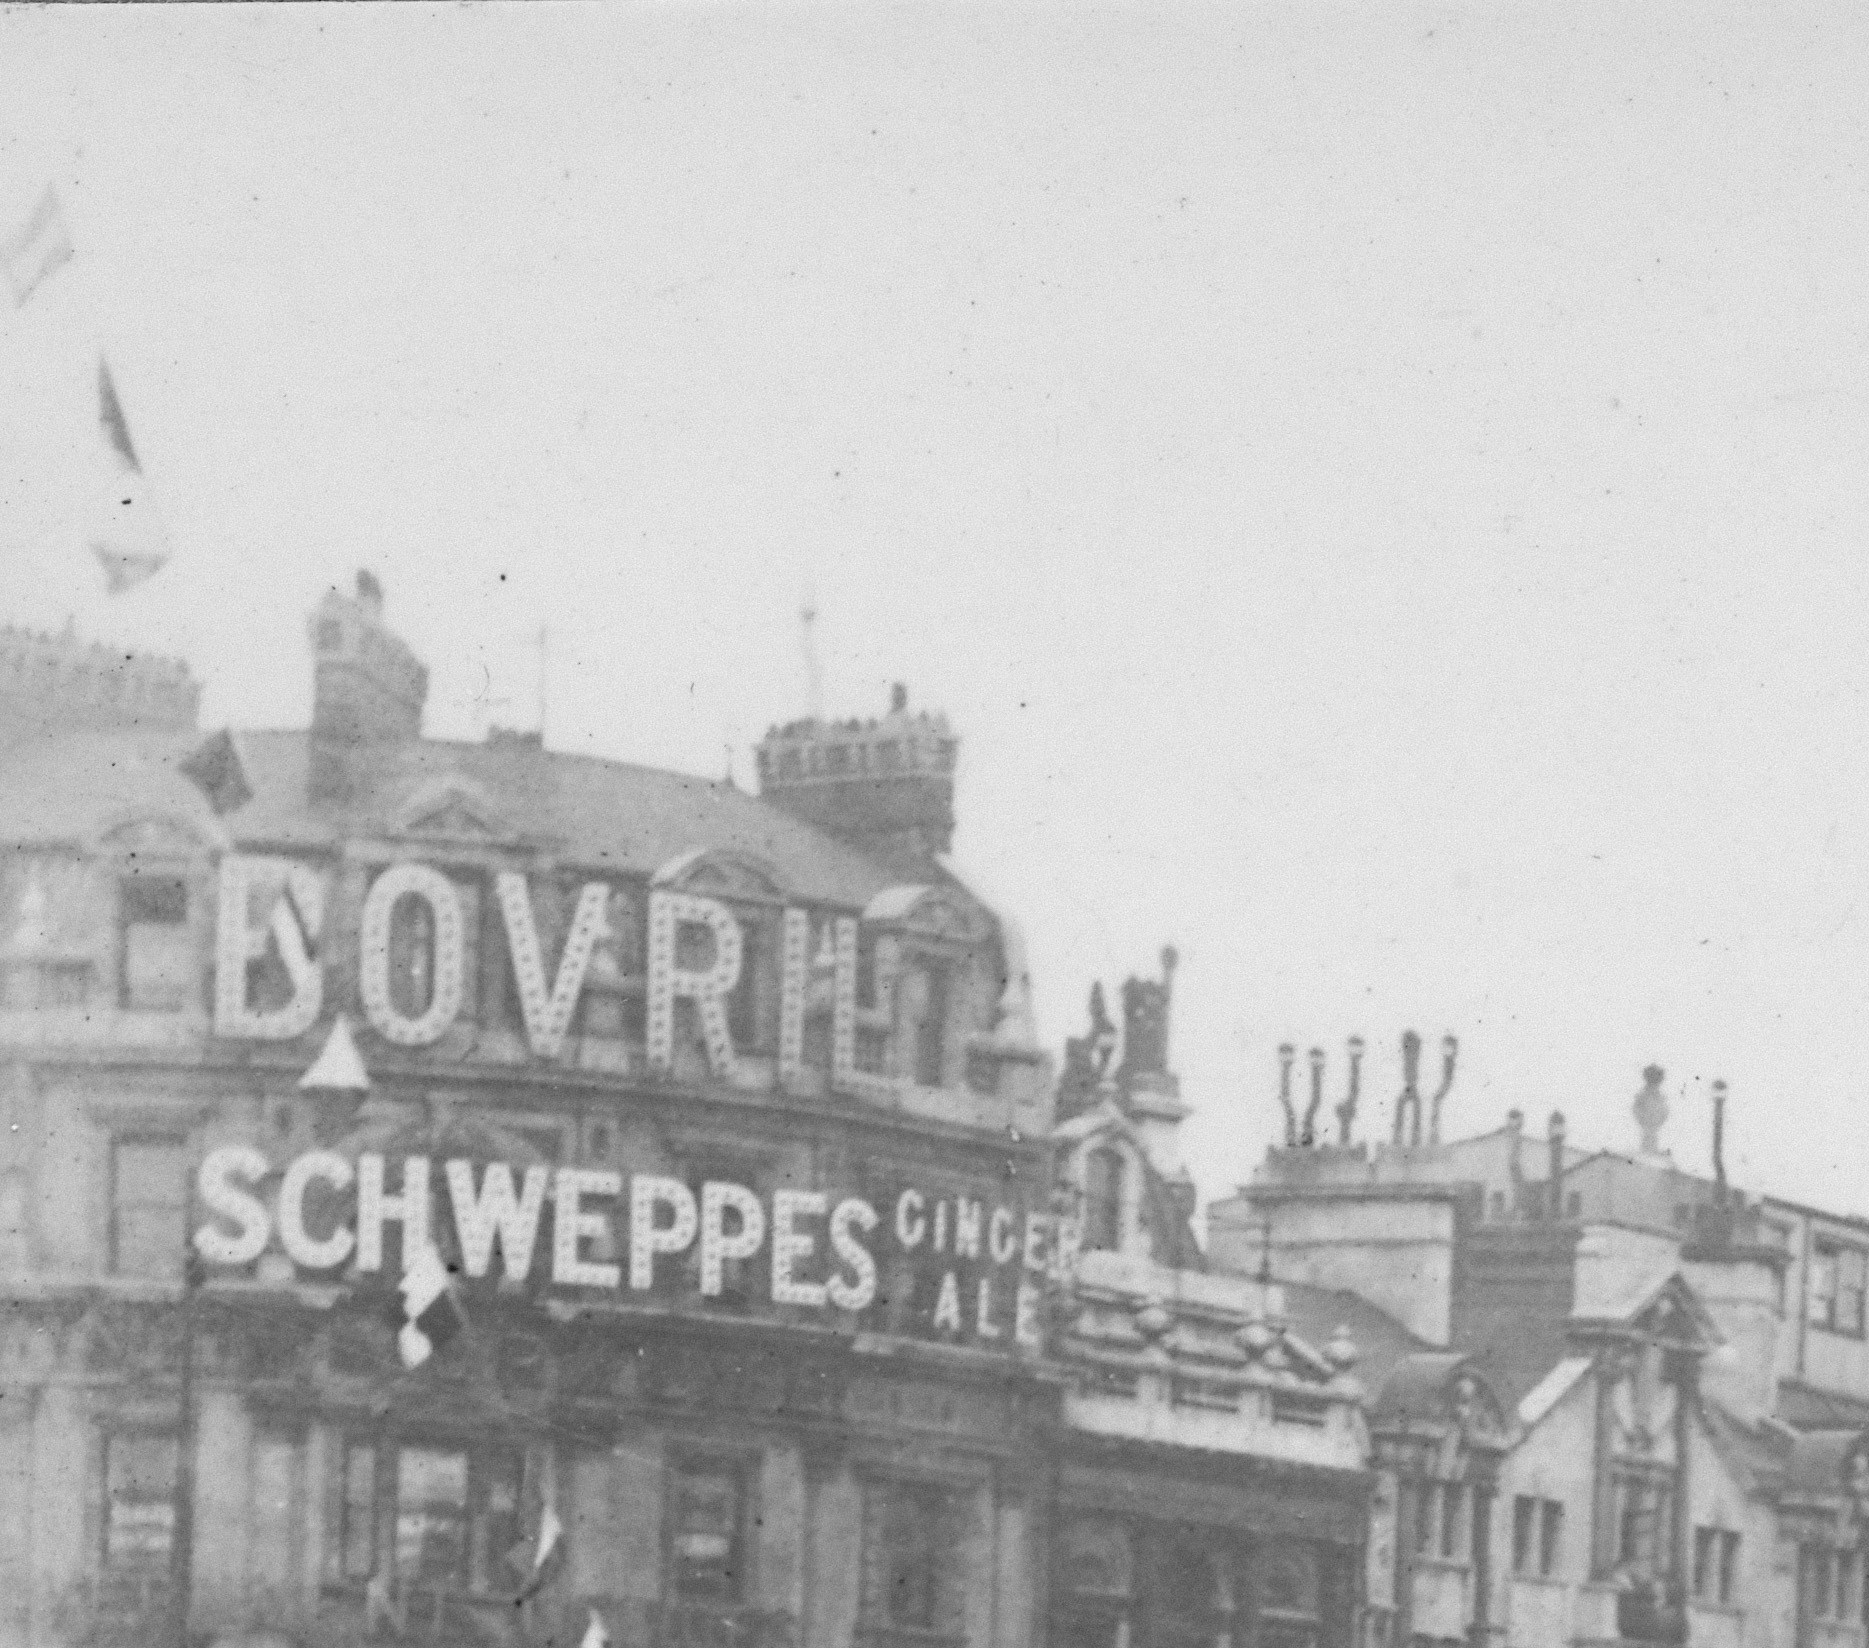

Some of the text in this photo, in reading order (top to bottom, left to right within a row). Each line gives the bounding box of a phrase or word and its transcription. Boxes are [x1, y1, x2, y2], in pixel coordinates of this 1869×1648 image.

[214, 855, 915, 1095] BOVRIL
[196, 1144, 880, 1310] SCHWEPPES
[894, 1186, 1084, 1282] GINGER
[932, 1270, 1042, 1346] ALE
